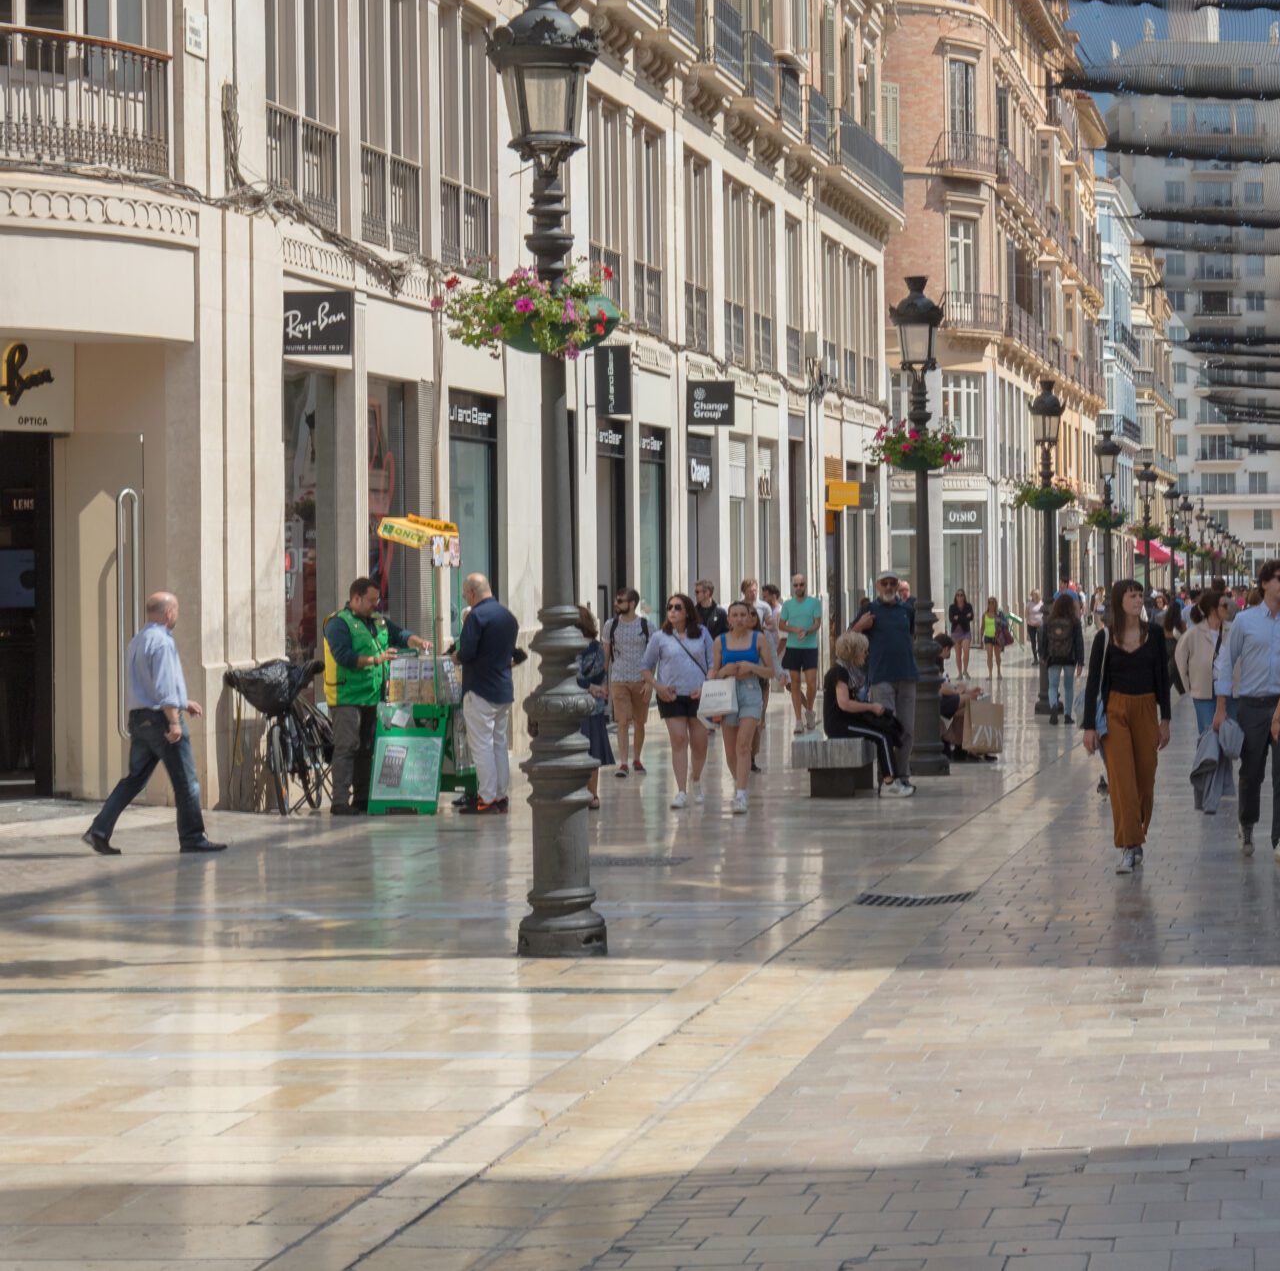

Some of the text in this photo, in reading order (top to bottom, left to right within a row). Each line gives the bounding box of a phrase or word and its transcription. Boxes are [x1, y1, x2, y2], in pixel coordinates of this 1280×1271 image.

[693, 401, 729, 411] Change
[693, 410, 721, 420] Group
[690, 457, 711, 489] Change
